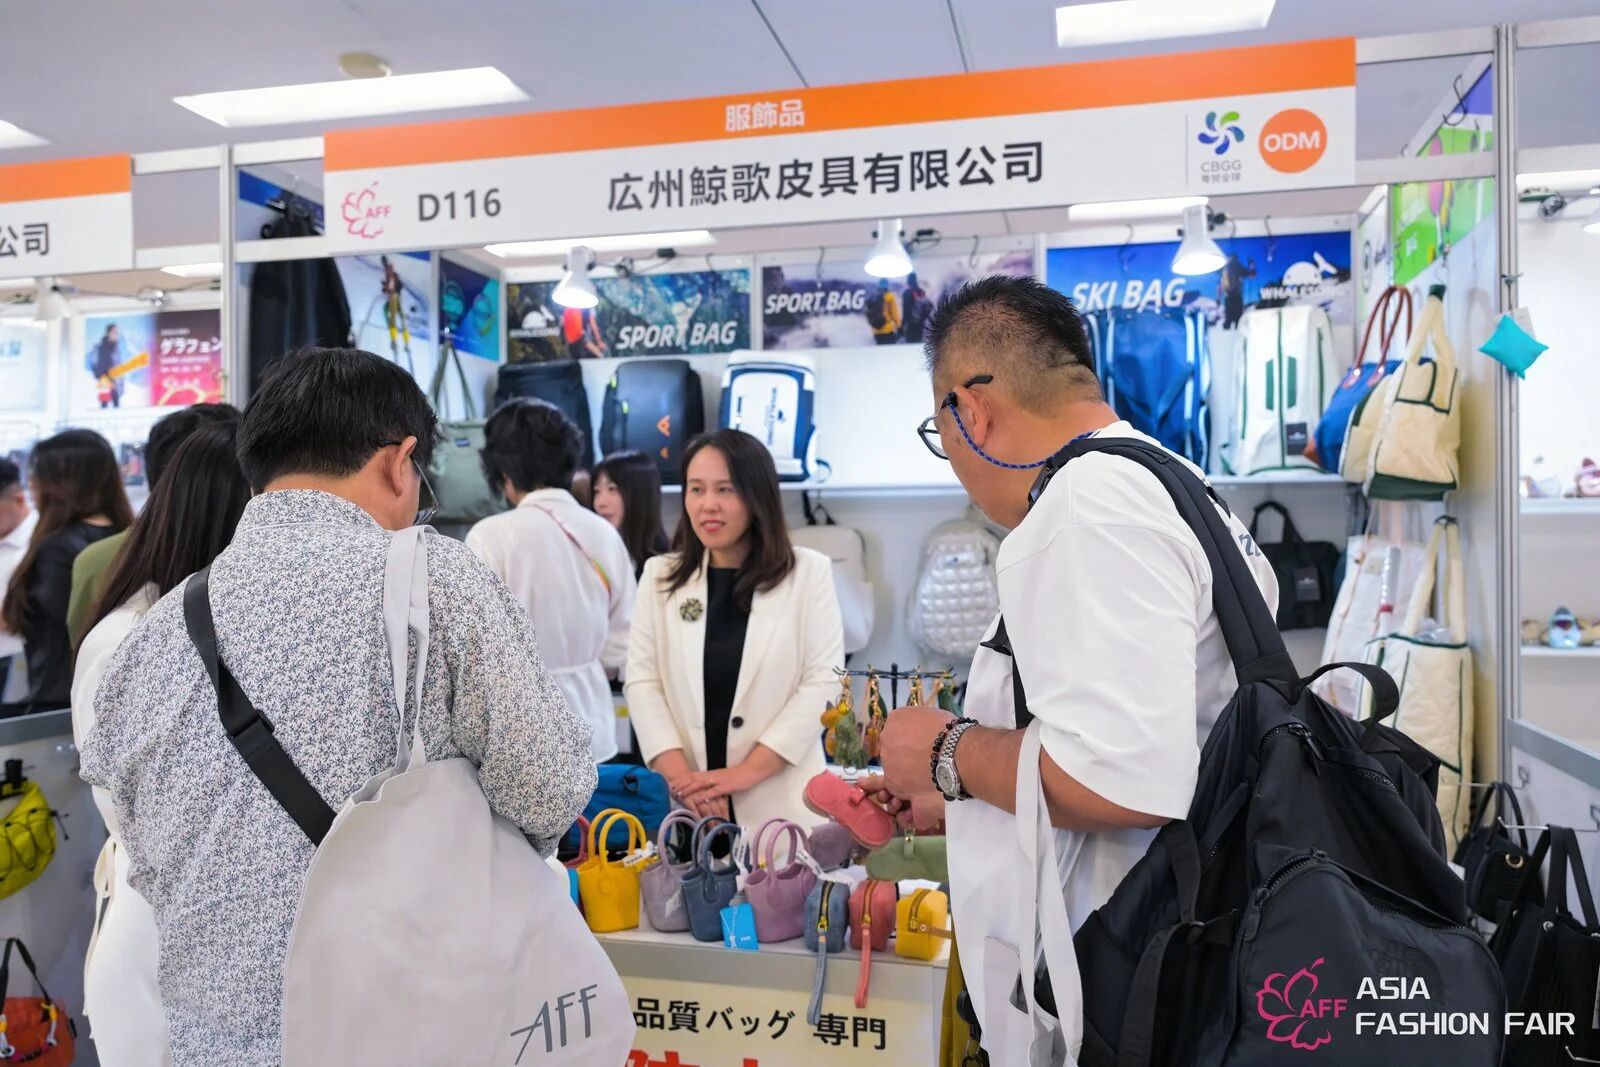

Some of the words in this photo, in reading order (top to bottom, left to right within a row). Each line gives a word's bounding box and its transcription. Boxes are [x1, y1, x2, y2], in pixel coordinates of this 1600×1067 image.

[725, 99, 805, 132] 服飾品
[1264, 130, 1321, 153] ODM
[608, 141, 1044, 212] 広州鯨歌皮具有限公司
[1200, 159, 1242, 173] CBGG
[366, 205, 392, 219] AFF
[418, 187, 502, 222] D116
[765, 290, 825, 315] SPORT
[826, 289, 866, 312] BAG
[1071, 280, 1118, 311] SKI
[1121, 277, 1187, 311] BAG
[616, 323, 687, 350] SPORT
[690, 321, 738, 346] BAG
[510, 983, 598, 1066] AFF
